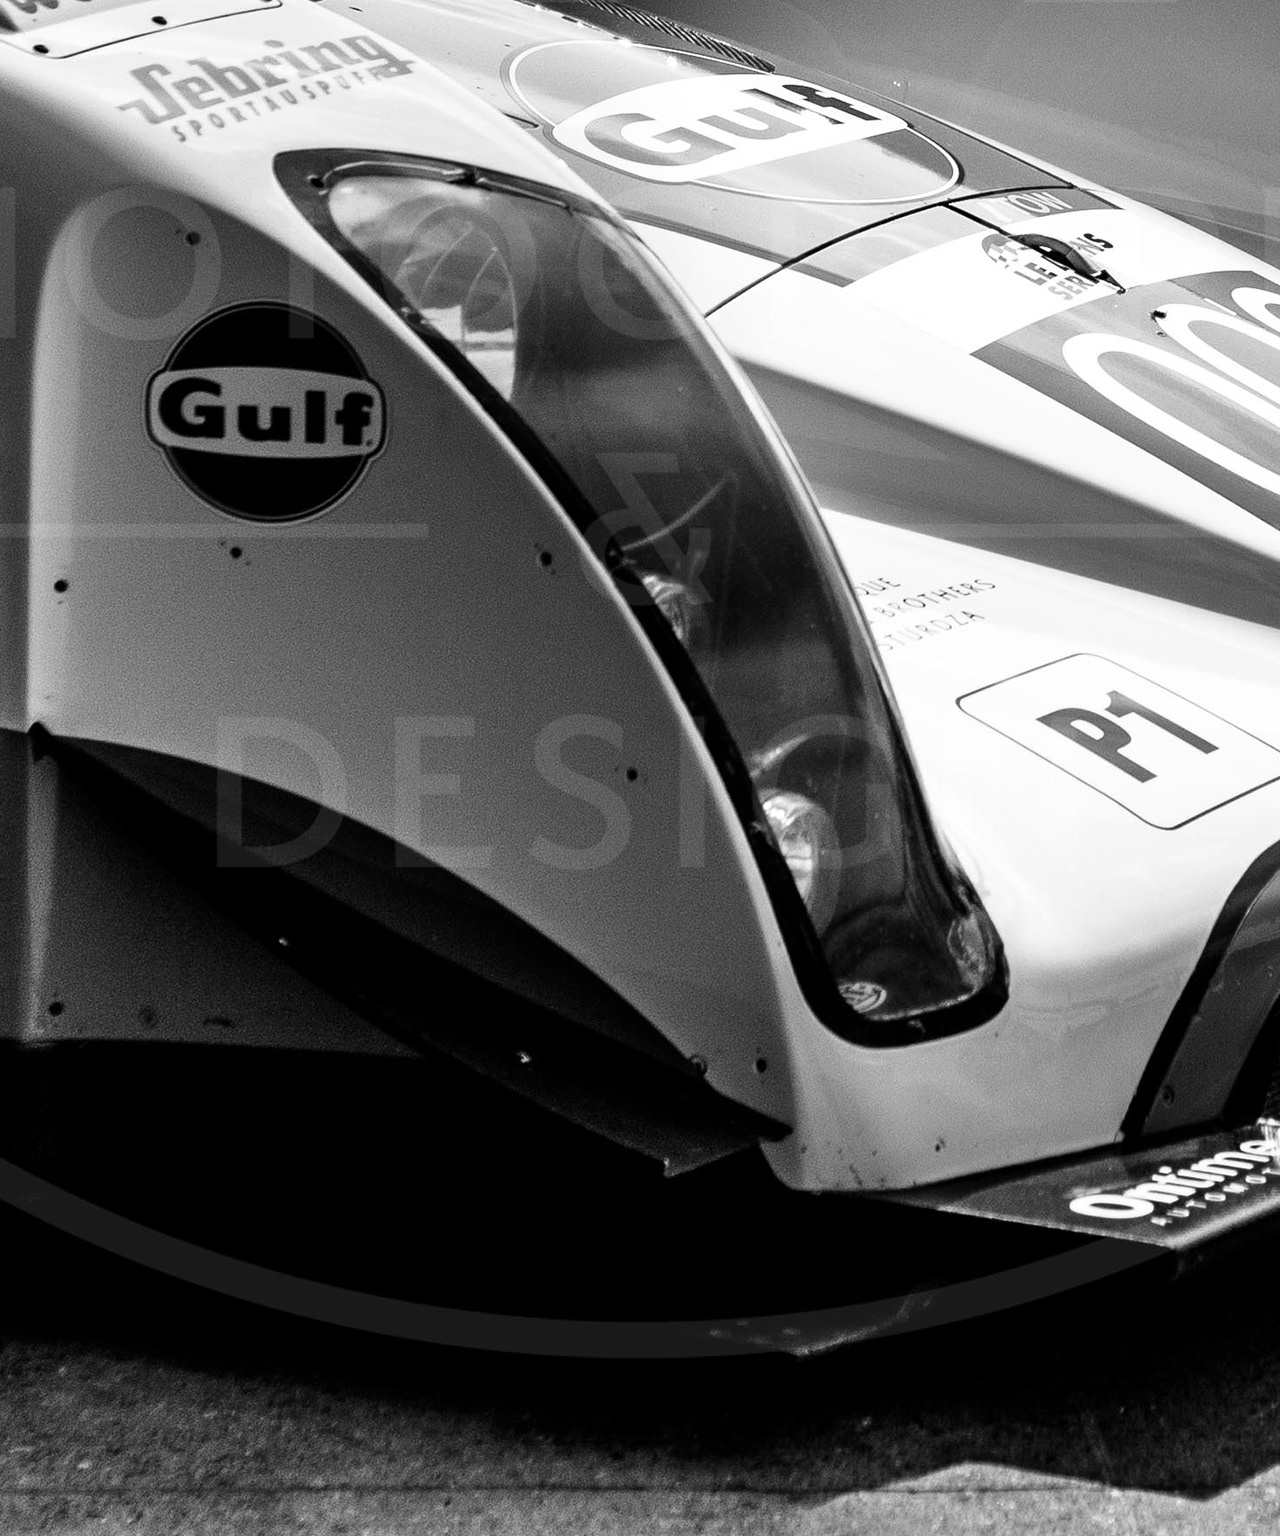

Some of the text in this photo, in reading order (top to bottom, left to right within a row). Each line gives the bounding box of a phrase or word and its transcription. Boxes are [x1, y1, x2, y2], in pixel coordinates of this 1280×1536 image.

[582, 84, 883, 167] Gulf
[157, 377, 375, 447] Gulf
[872, 578, 997, 618] BROTHERS
[1035, 690, 1220, 784] P1
